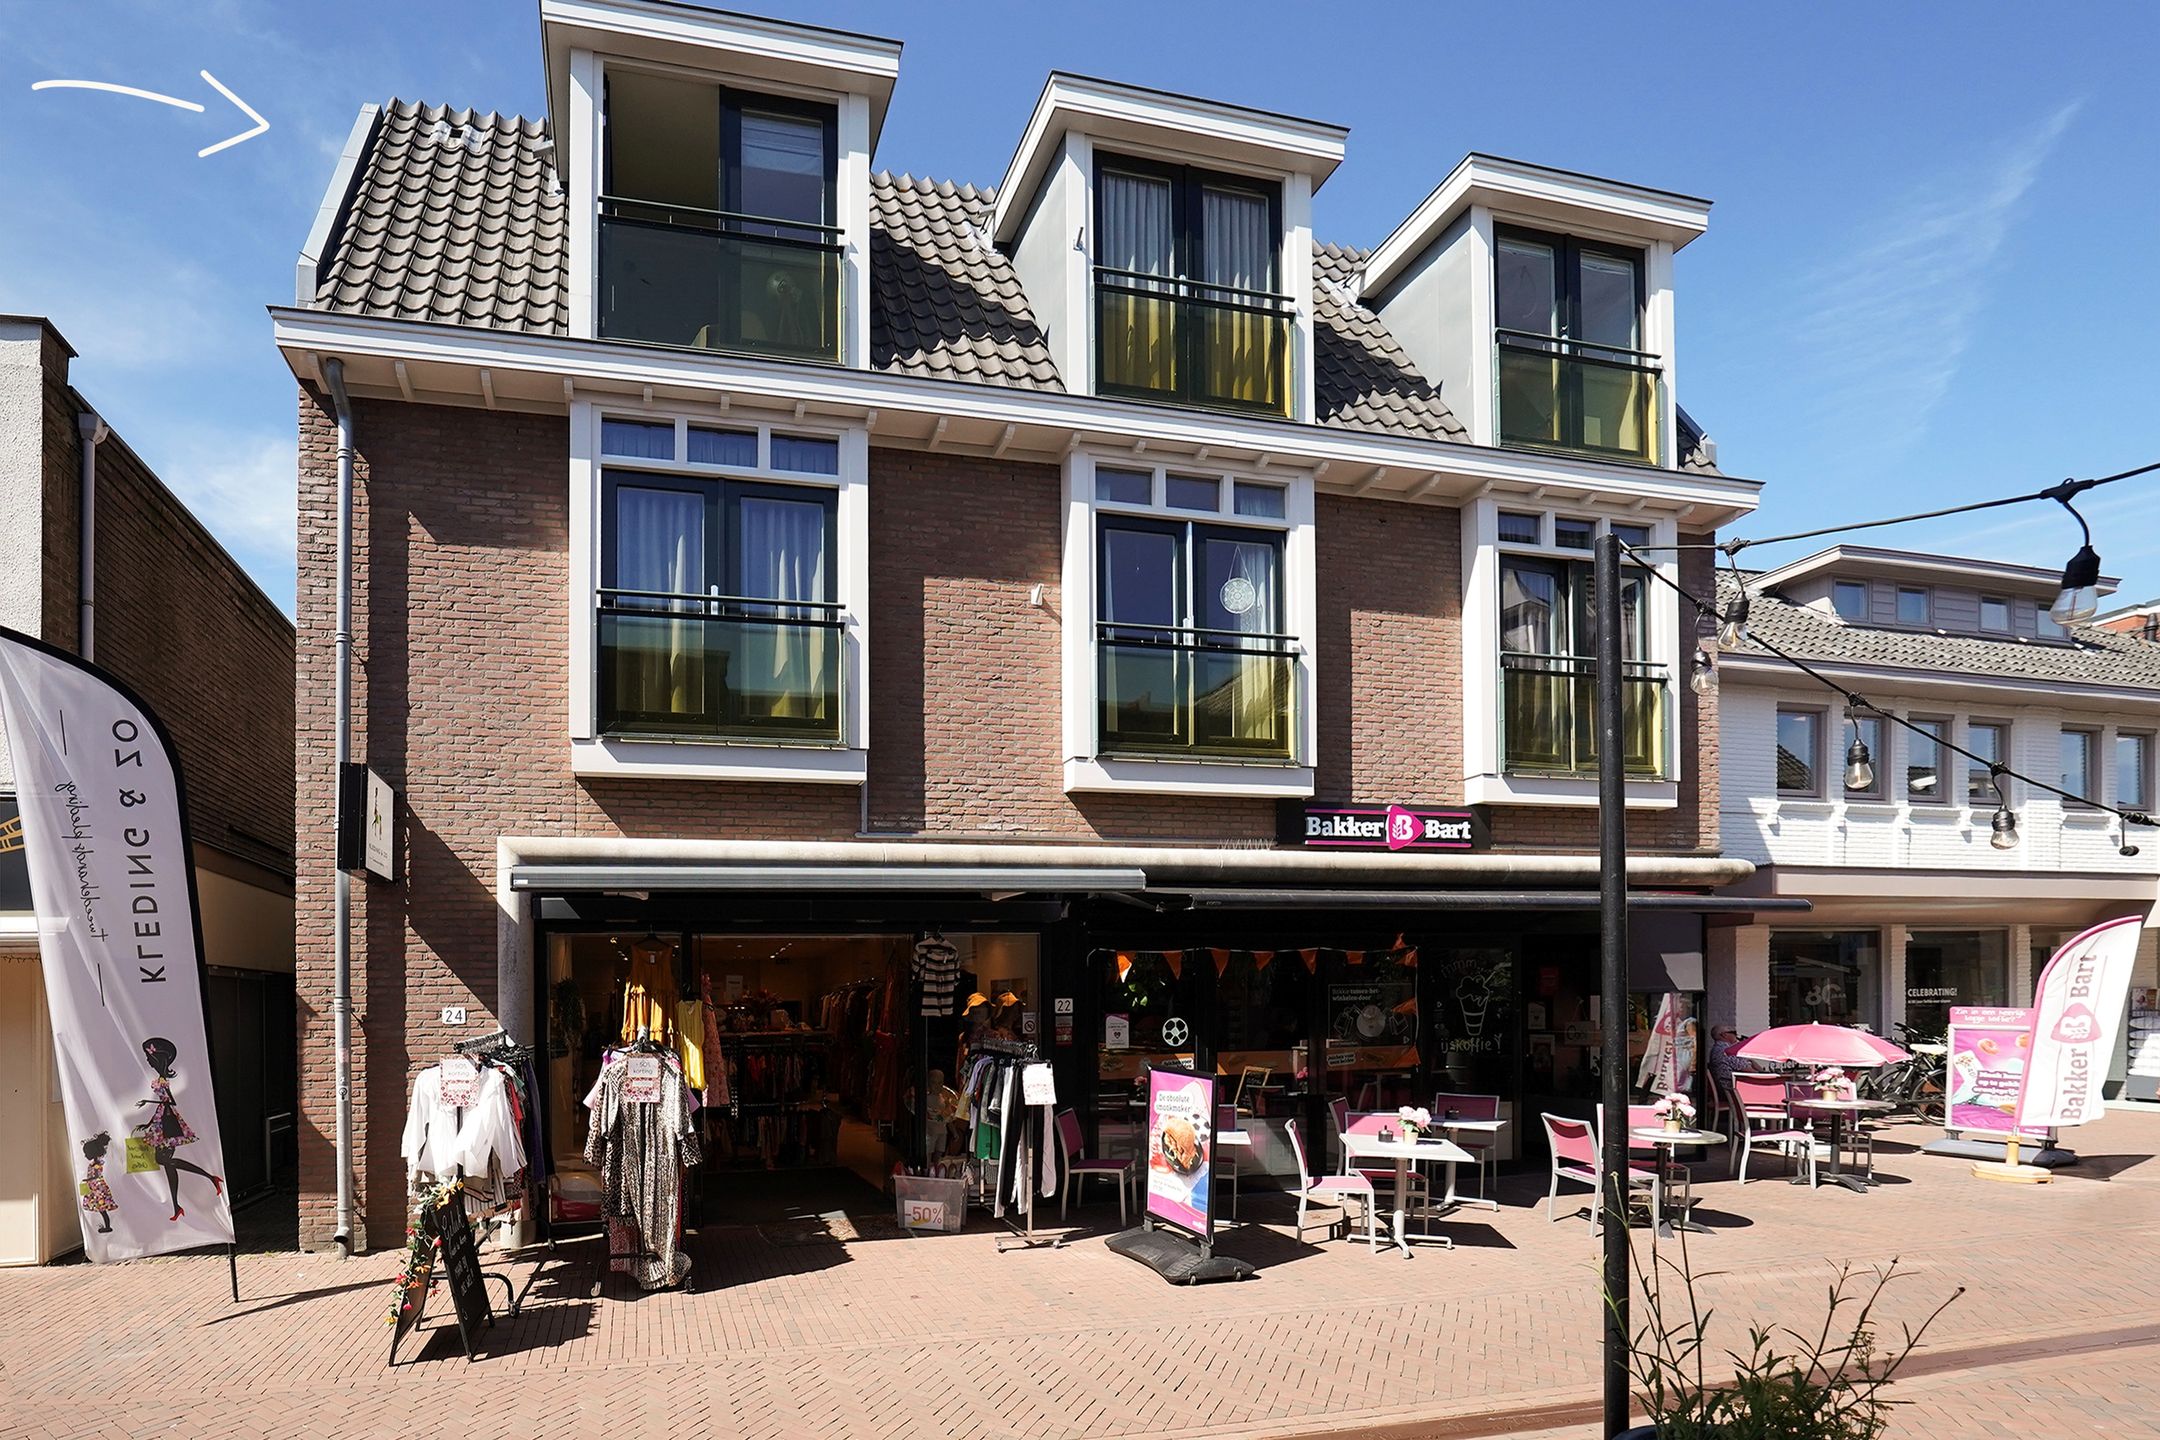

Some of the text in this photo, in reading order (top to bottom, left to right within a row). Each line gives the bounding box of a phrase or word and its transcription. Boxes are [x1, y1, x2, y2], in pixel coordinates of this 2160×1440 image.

[1305, 816, 1384, 837] Bakker
[1424, 819, 1472, 839] Bart
[2069, 954, 2098, 998] Bart
[1907, 987, 1958, 997] CELEBRATING!
[445, 1009, 463, 1022] 24
[1057, 999, 1071, 1012] 22
[2060, 1048, 2088, 1121] Bakker
[905, 1203, 944, 1224] -50%
